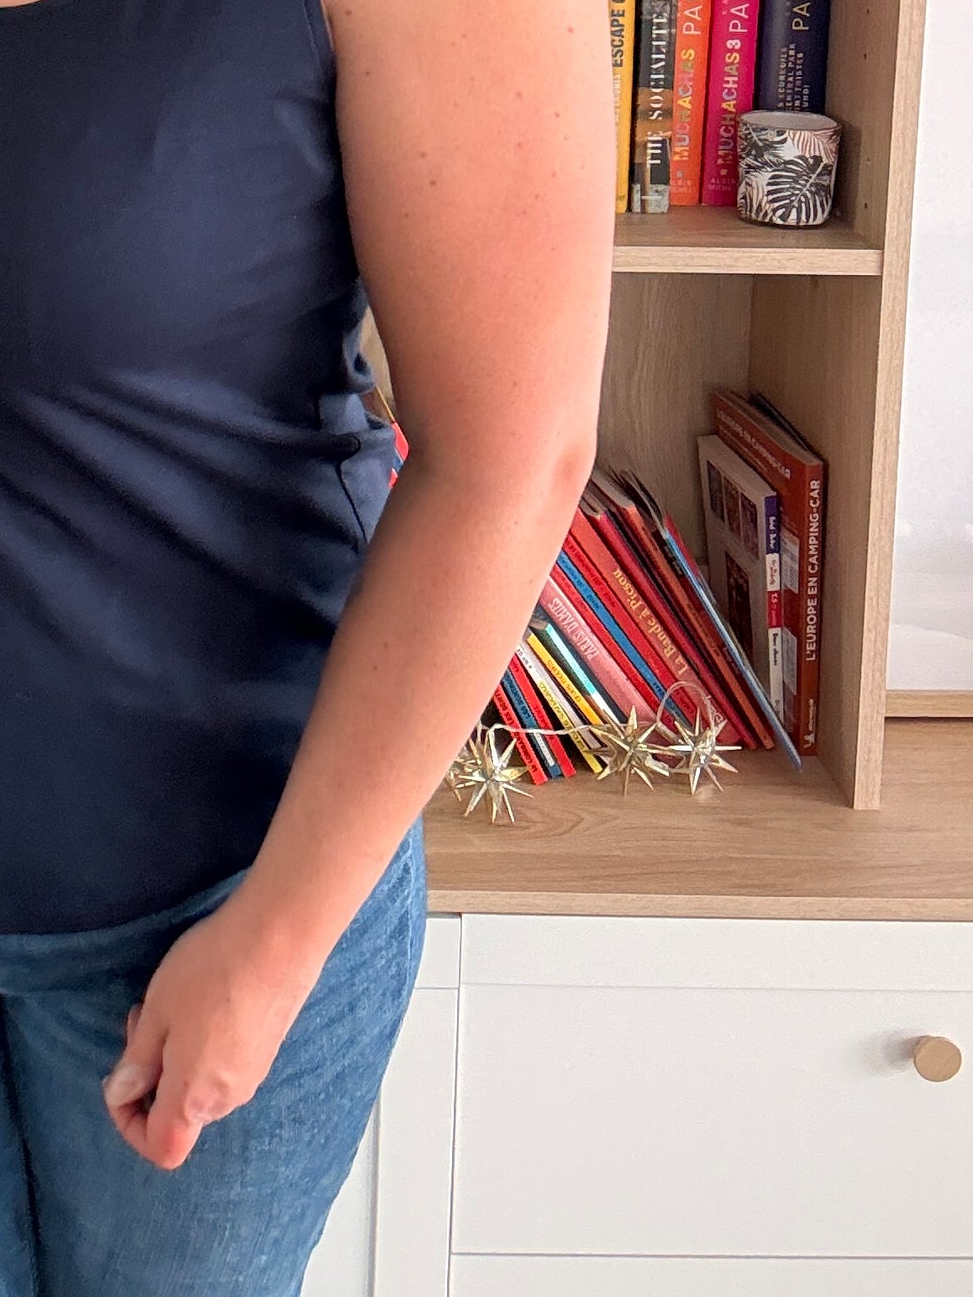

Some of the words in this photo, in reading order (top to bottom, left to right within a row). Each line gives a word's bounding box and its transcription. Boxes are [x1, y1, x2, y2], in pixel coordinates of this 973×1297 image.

[610, 9, 625, 67] ESCAPE
[727, 39, 741, 49] 3
[673, 48, 695, 162] MUCHACHAS
[715, 52, 740, 165] MUCHACHAS
[808, 480, 821, 573] CAMPING-CAR
[613, 569, 644, 611] Picsou
[807, 576, 818, 593] EN
[640, 614, 649, 625] à
[806, 597, 818, 661] L'EUROPE
[647, 625, 675, 657] Bande
[674, 656, 688, 674] La
